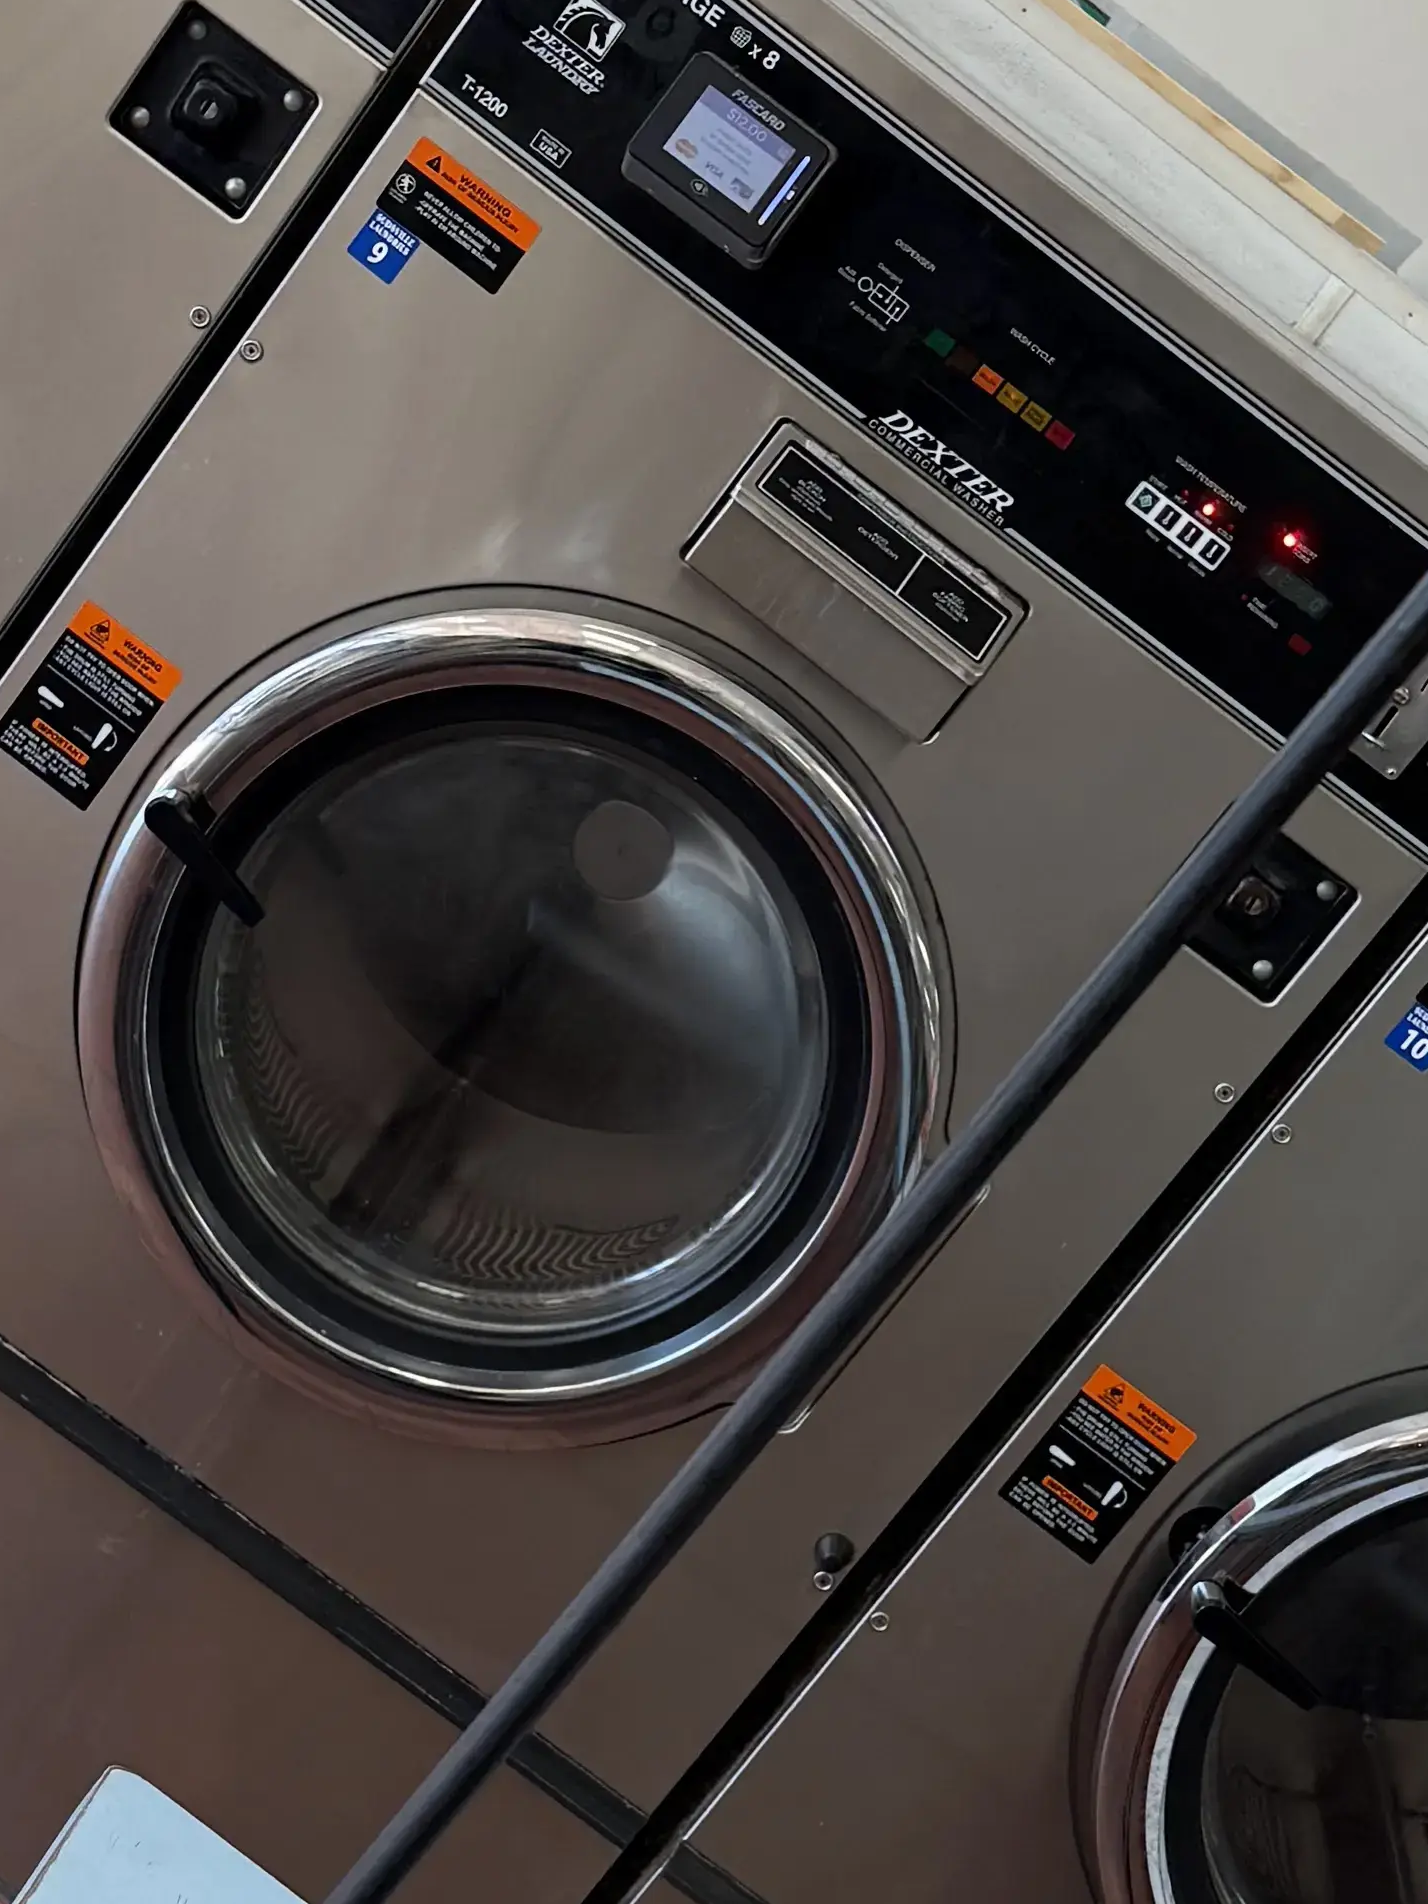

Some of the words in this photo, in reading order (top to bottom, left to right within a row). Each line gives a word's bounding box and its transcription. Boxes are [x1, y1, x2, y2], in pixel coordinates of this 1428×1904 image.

[521, 35, 600, 98] LAUNDRY
[530, 23, 606, 85] DEXTER
[759, 48, 782, 72] 8
[457, 73, 509, 120] T-1200
[730, 86, 786, 133] FASCARD
[457, 173, 512, 218] WARNING
[364, 238, 391, 267] 9
[866, 417, 951, 486] COMMERCIAL
[950, 482, 1005, 527] WASHER
[877, 403, 1016, 515] DEXTER
